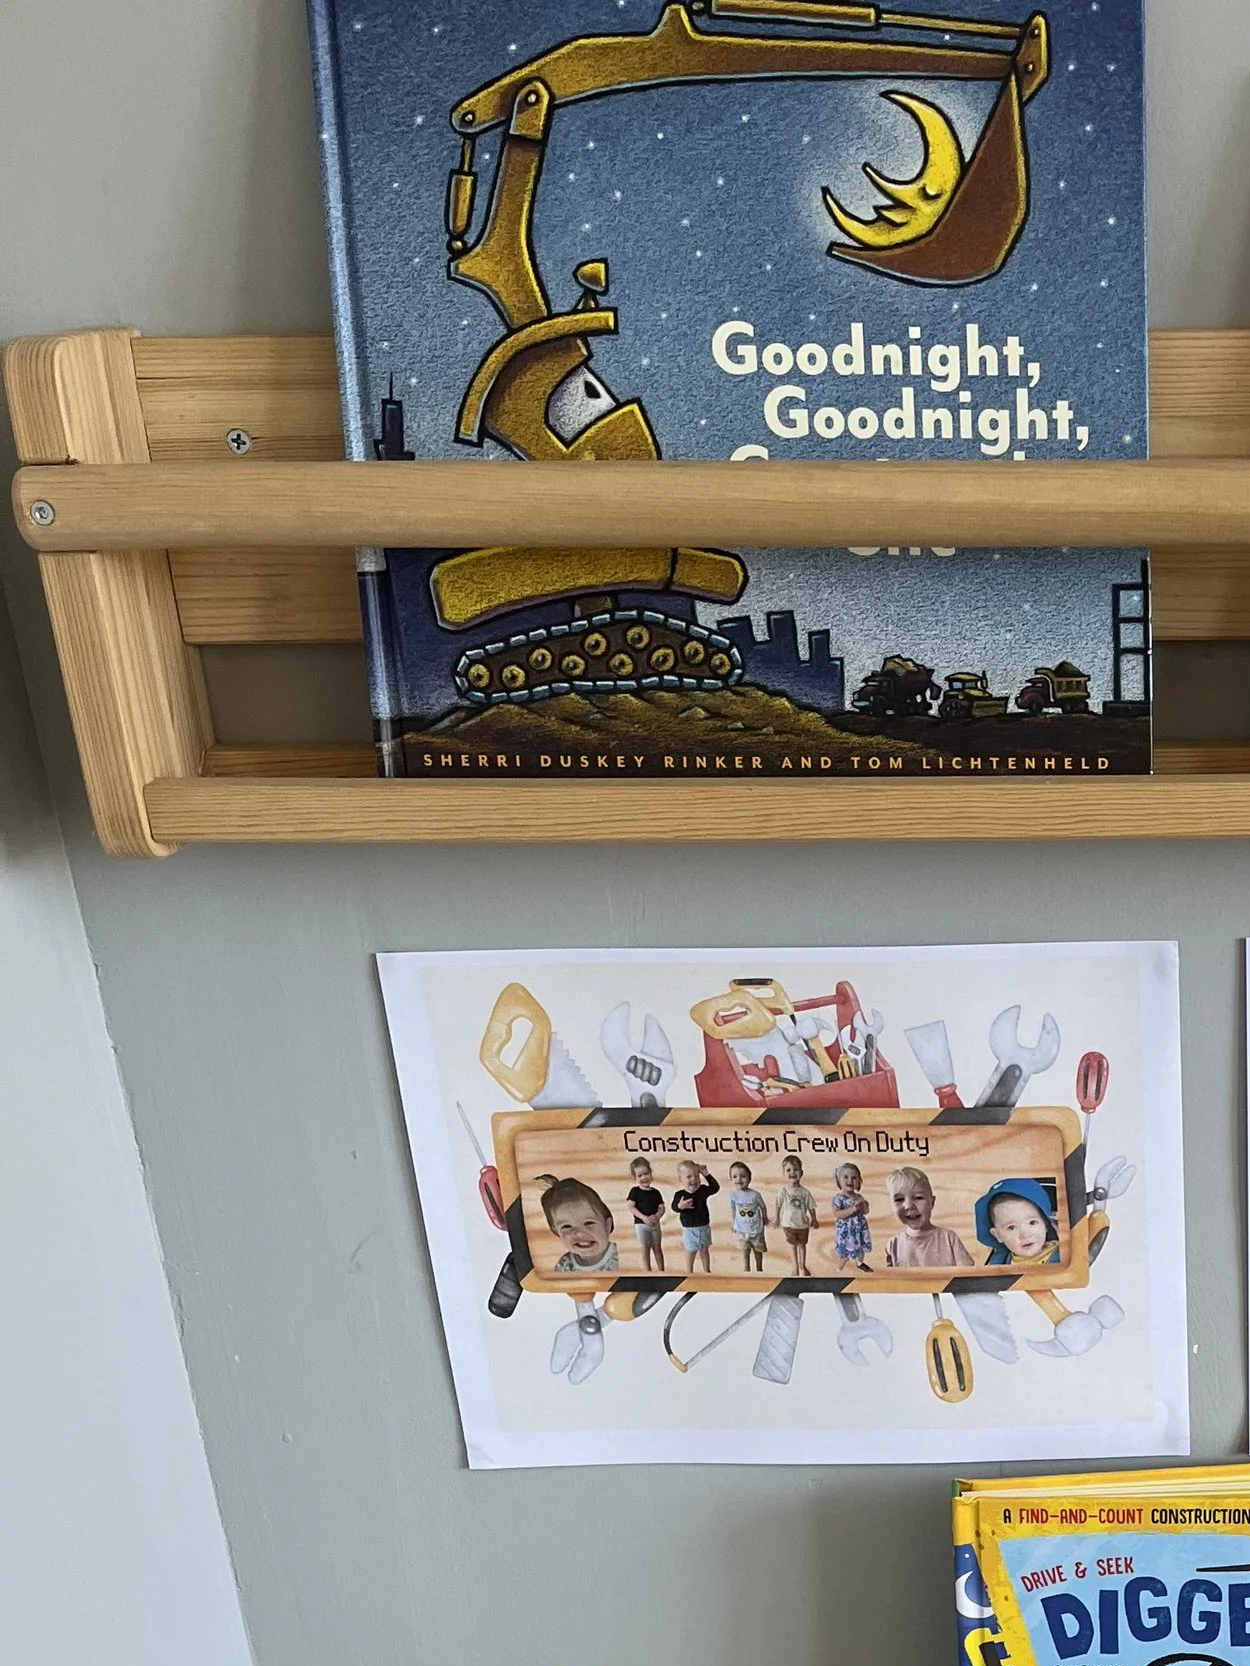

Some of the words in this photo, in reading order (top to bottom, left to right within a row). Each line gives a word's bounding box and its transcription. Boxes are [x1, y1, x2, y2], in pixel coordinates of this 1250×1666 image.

[711, 320, 1042, 393] Goodnight,
[763, 384, 1090, 456] Goodnight,
[423, 753, 521, 768] SHERRI
[540, 754, 645, 769] DUSKEY
[664, 755, 764, 770] RINKER
[781, 755, 832, 770] AND
[851, 756, 904, 770] TOM
[922, 756, 1110, 770] LICHTENHELD
[623, 1130, 780, 1154] Construction
[782, 1130, 839, 1154] Crew
[843, 1130, 871, 1154] On
[876, 1131, 930, 1157] Duty
[1003, 1508, 1012, 1525] A
[1019, 1508, 1144, 1525] FIND-AND-COUNT
[1020, 1565, 1068, 1593] DRIVE
[1074, 1561, 1088, 1580] &
[1096, 1556, 1135, 1577] SEEK
